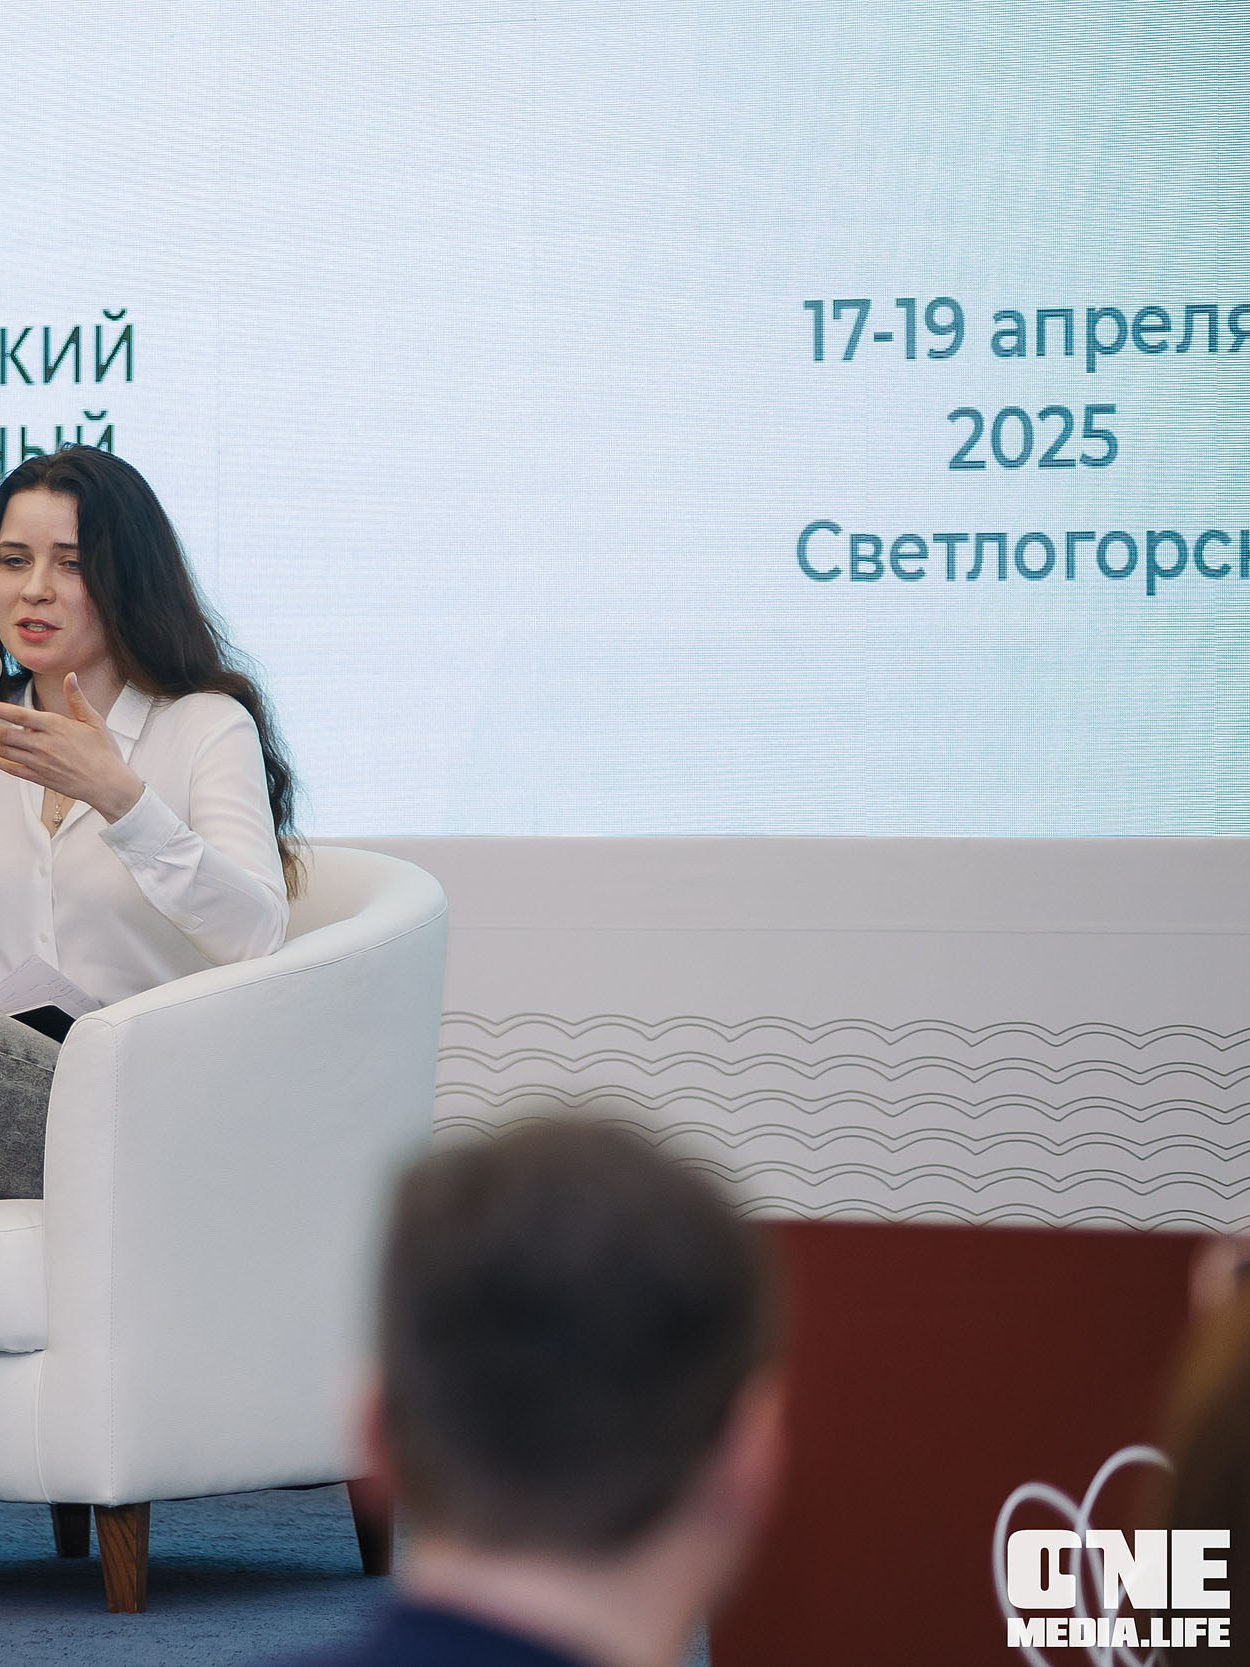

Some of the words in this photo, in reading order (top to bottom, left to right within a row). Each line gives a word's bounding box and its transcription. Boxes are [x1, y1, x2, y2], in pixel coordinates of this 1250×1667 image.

[803, 296, 965, 361] 17-19
[990, 302, 1250, 374] апреля
[946, 403, 1120, 470] 2025
